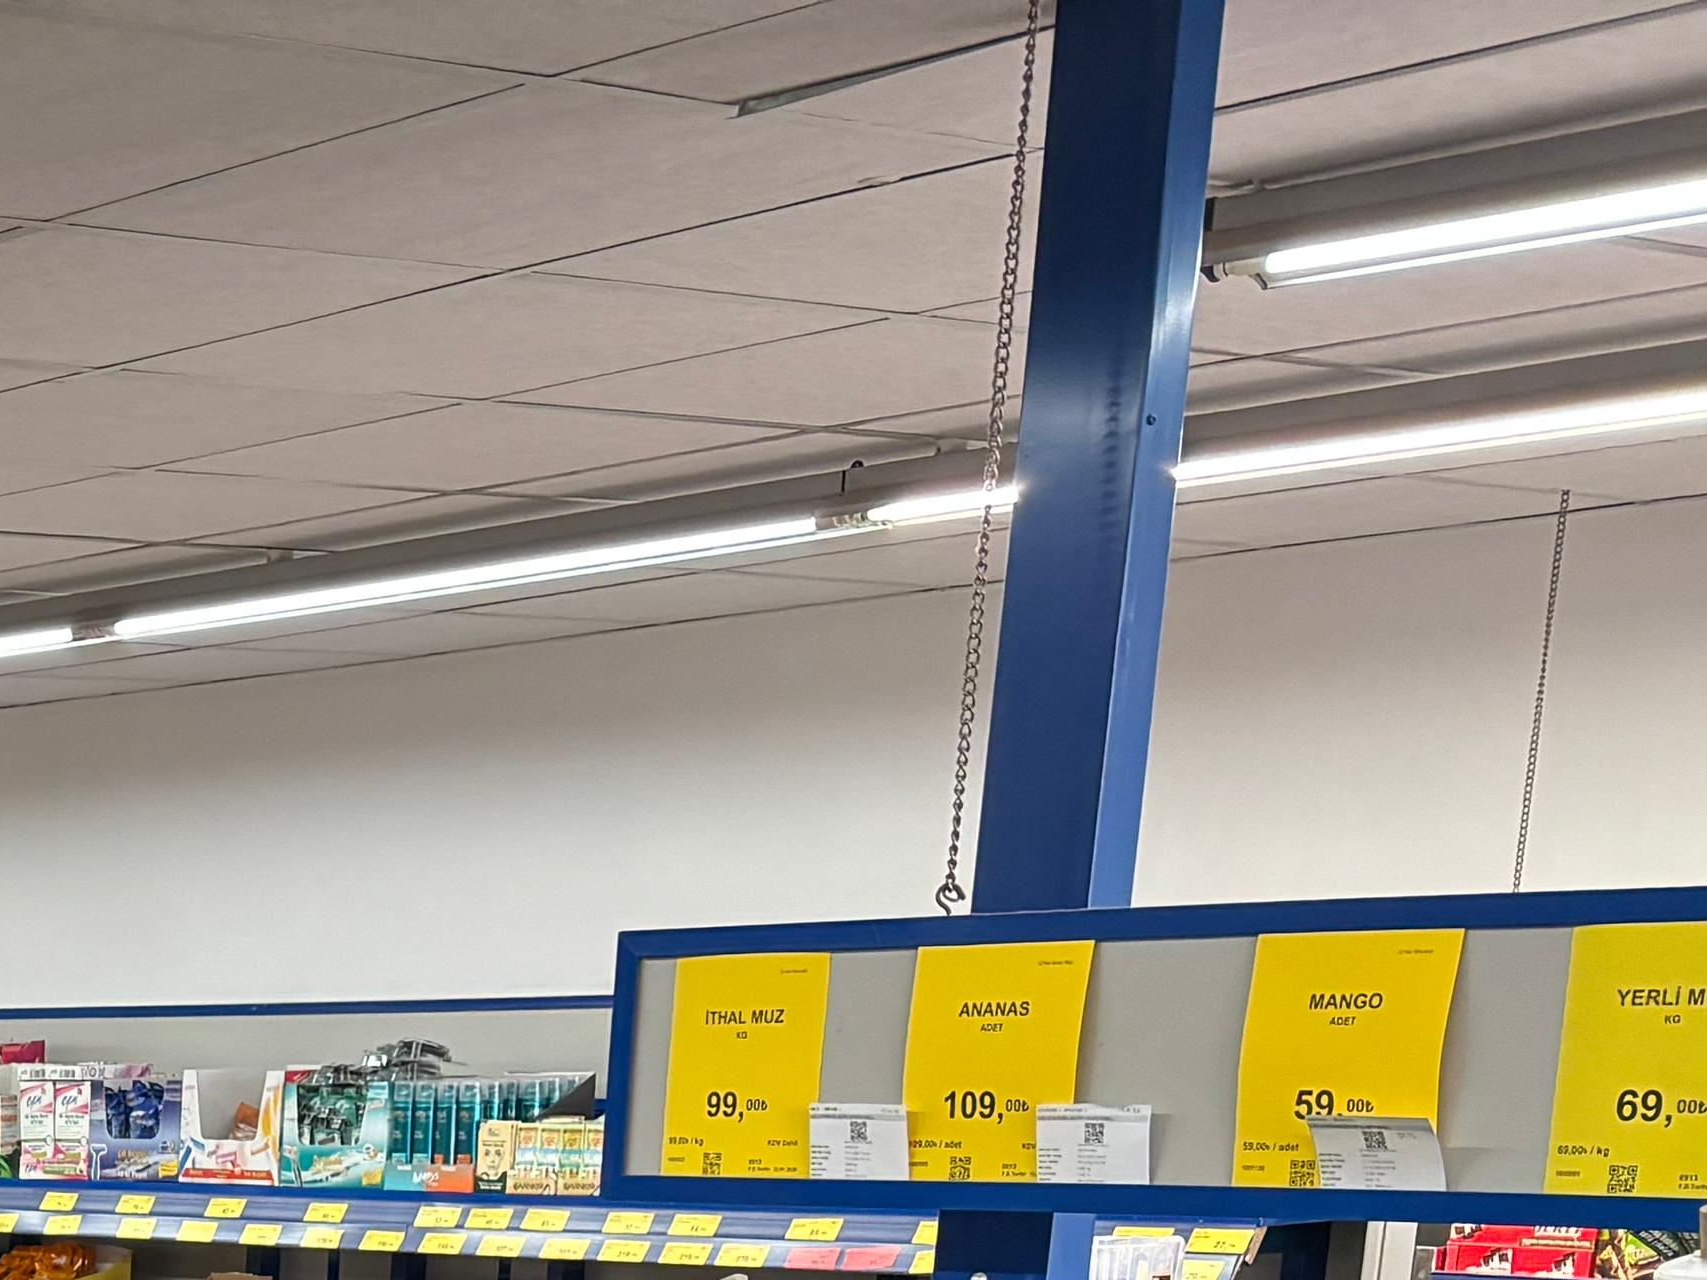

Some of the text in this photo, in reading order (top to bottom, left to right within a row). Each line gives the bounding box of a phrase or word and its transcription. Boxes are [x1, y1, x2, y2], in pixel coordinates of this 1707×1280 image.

[1309, 992, 1383, 1010] MANGO
[1617, 986, 1683, 1007] YERLİ
[751, 1009, 785, 1025] MUZ
[958, 1001, 1030, 1018] ANANAS
[980, 1023, 1003, 1032] ADET
[1329, 1016, 1356, 1026] ADET
